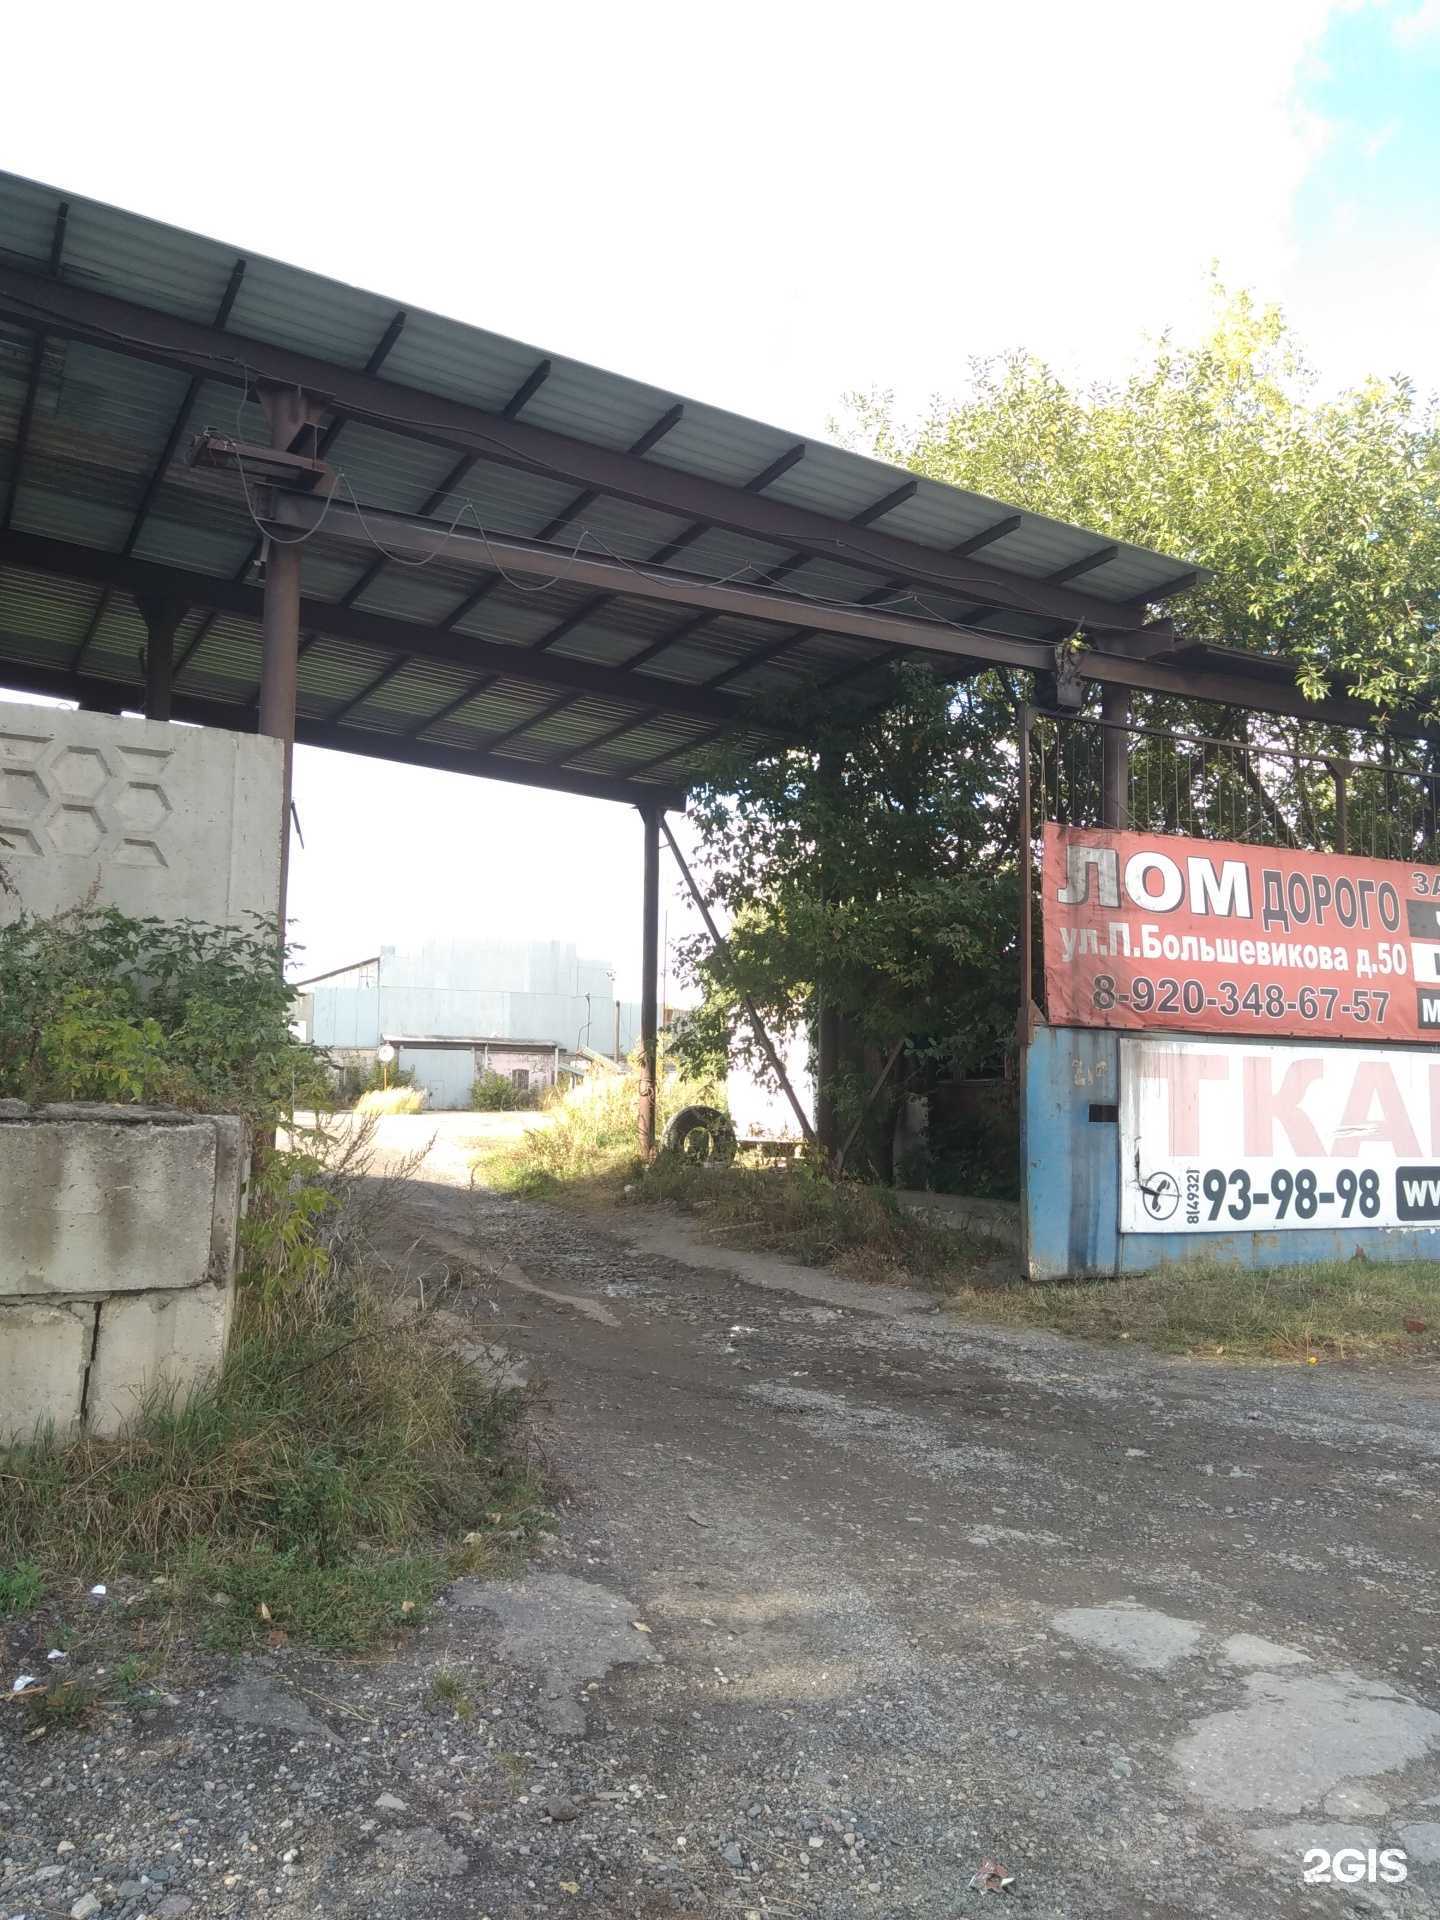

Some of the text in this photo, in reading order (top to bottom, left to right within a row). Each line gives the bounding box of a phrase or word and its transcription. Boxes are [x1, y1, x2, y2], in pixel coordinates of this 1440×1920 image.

[1057, 845, 1400, 933] ЛОМ ДОРОГО
[1356, 942, 1408, 978] д.50
[1093, 974, 1390, 1024] 8-920-348-67-57
[1186, 1169, 1200, 1225] 8(4932)
[1203, 1168, 1381, 1221] 93-98-98
